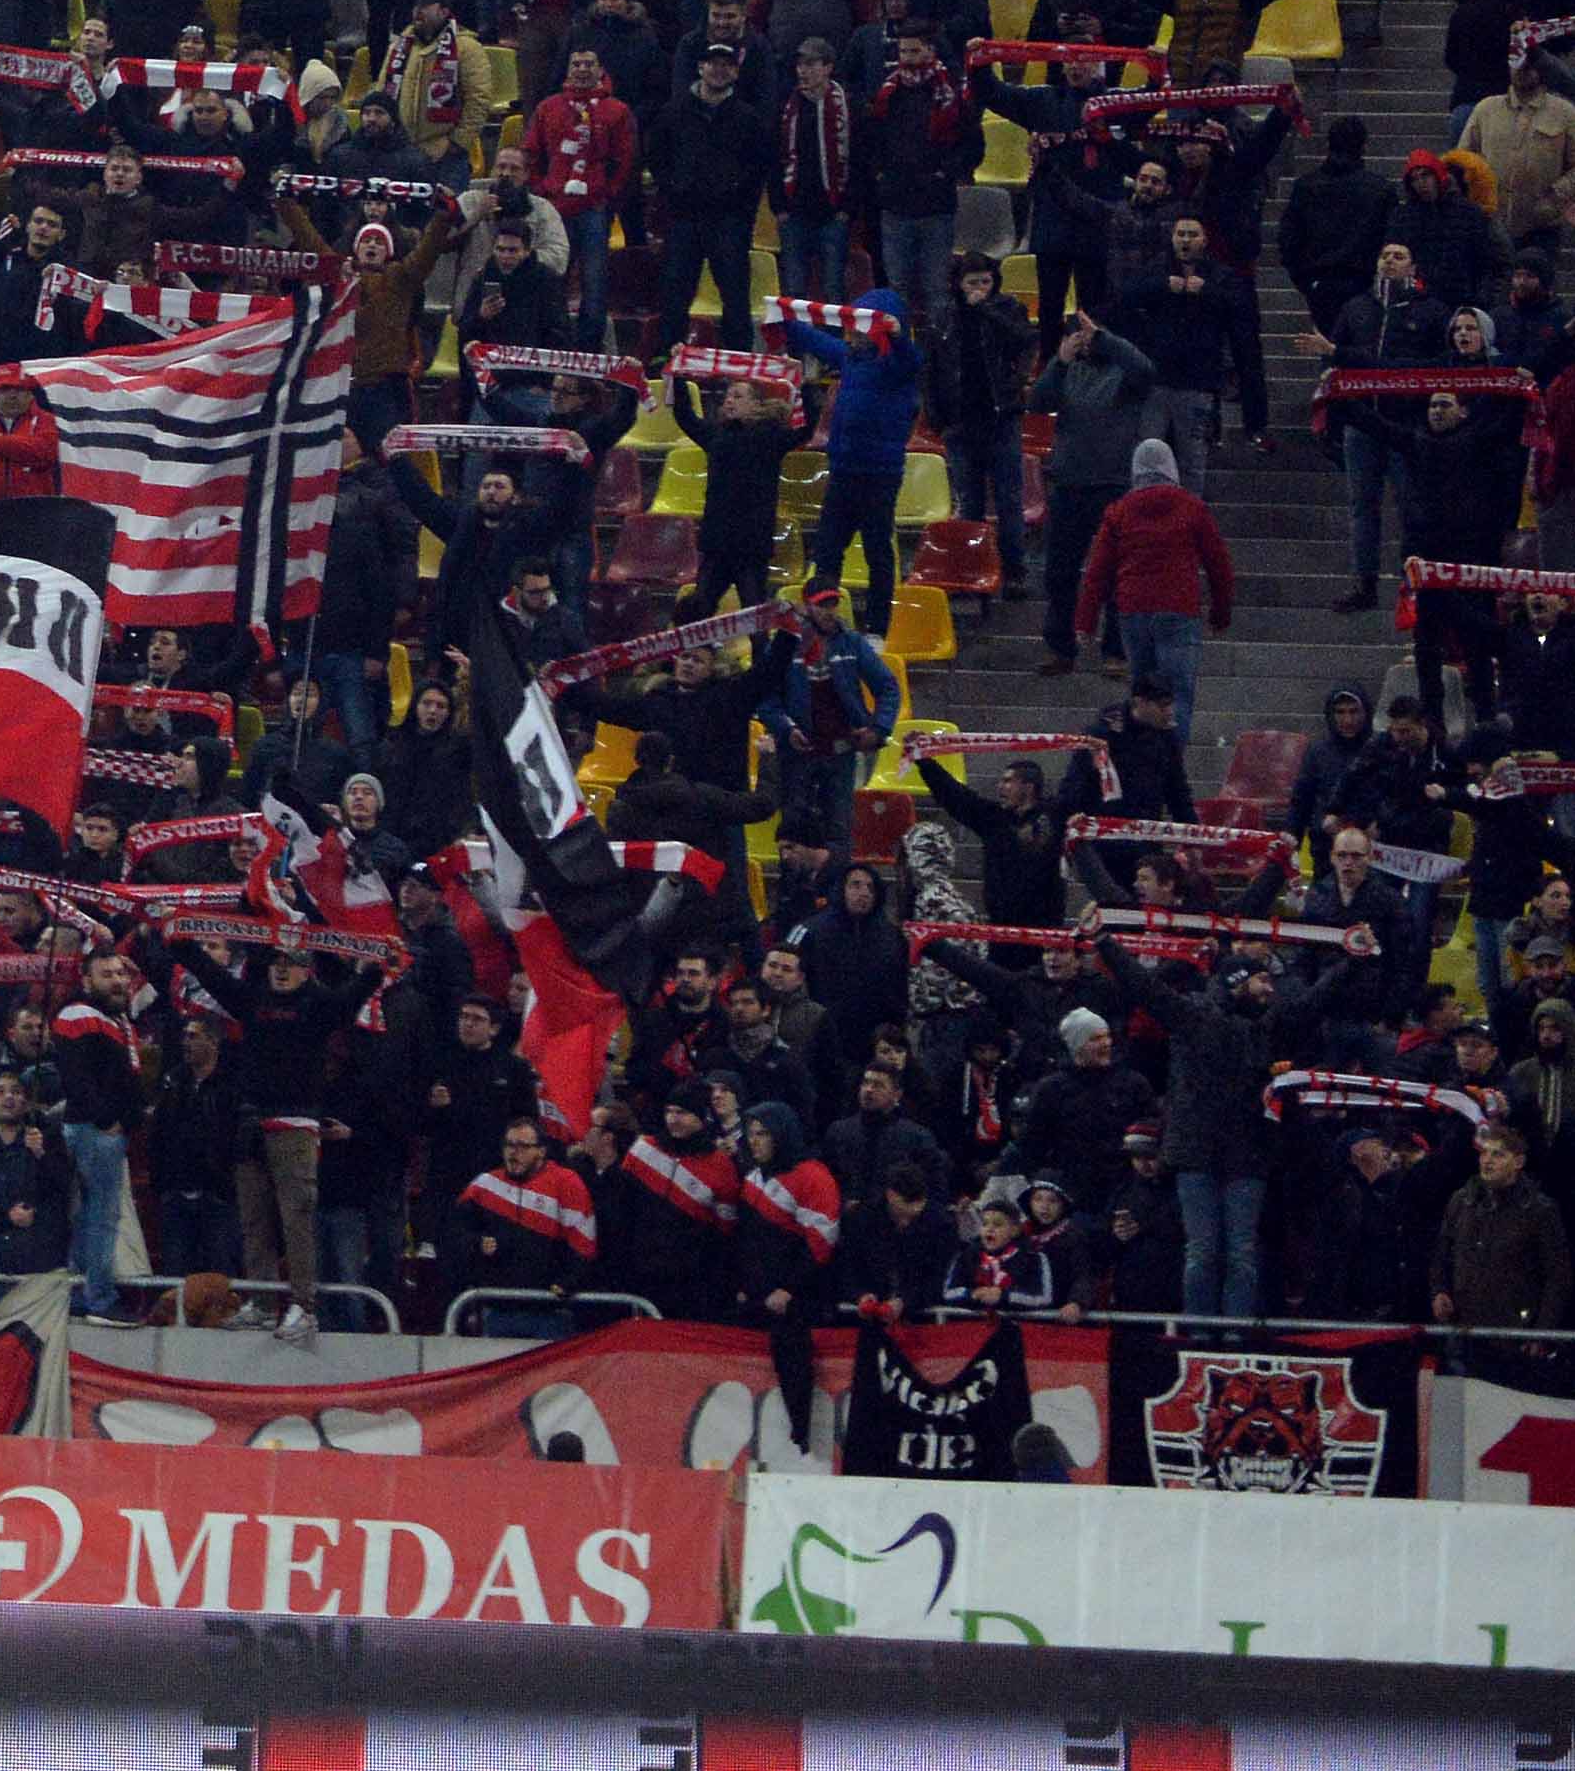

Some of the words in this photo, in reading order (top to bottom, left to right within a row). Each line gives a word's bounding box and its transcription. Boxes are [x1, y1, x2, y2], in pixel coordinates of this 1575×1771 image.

[172, 244, 211, 263] F.C.
[219, 248, 319, 269] DINAMO
[1421, 564, 1455, 582] FC
[119, 1507, 653, 1630] MEDAS
